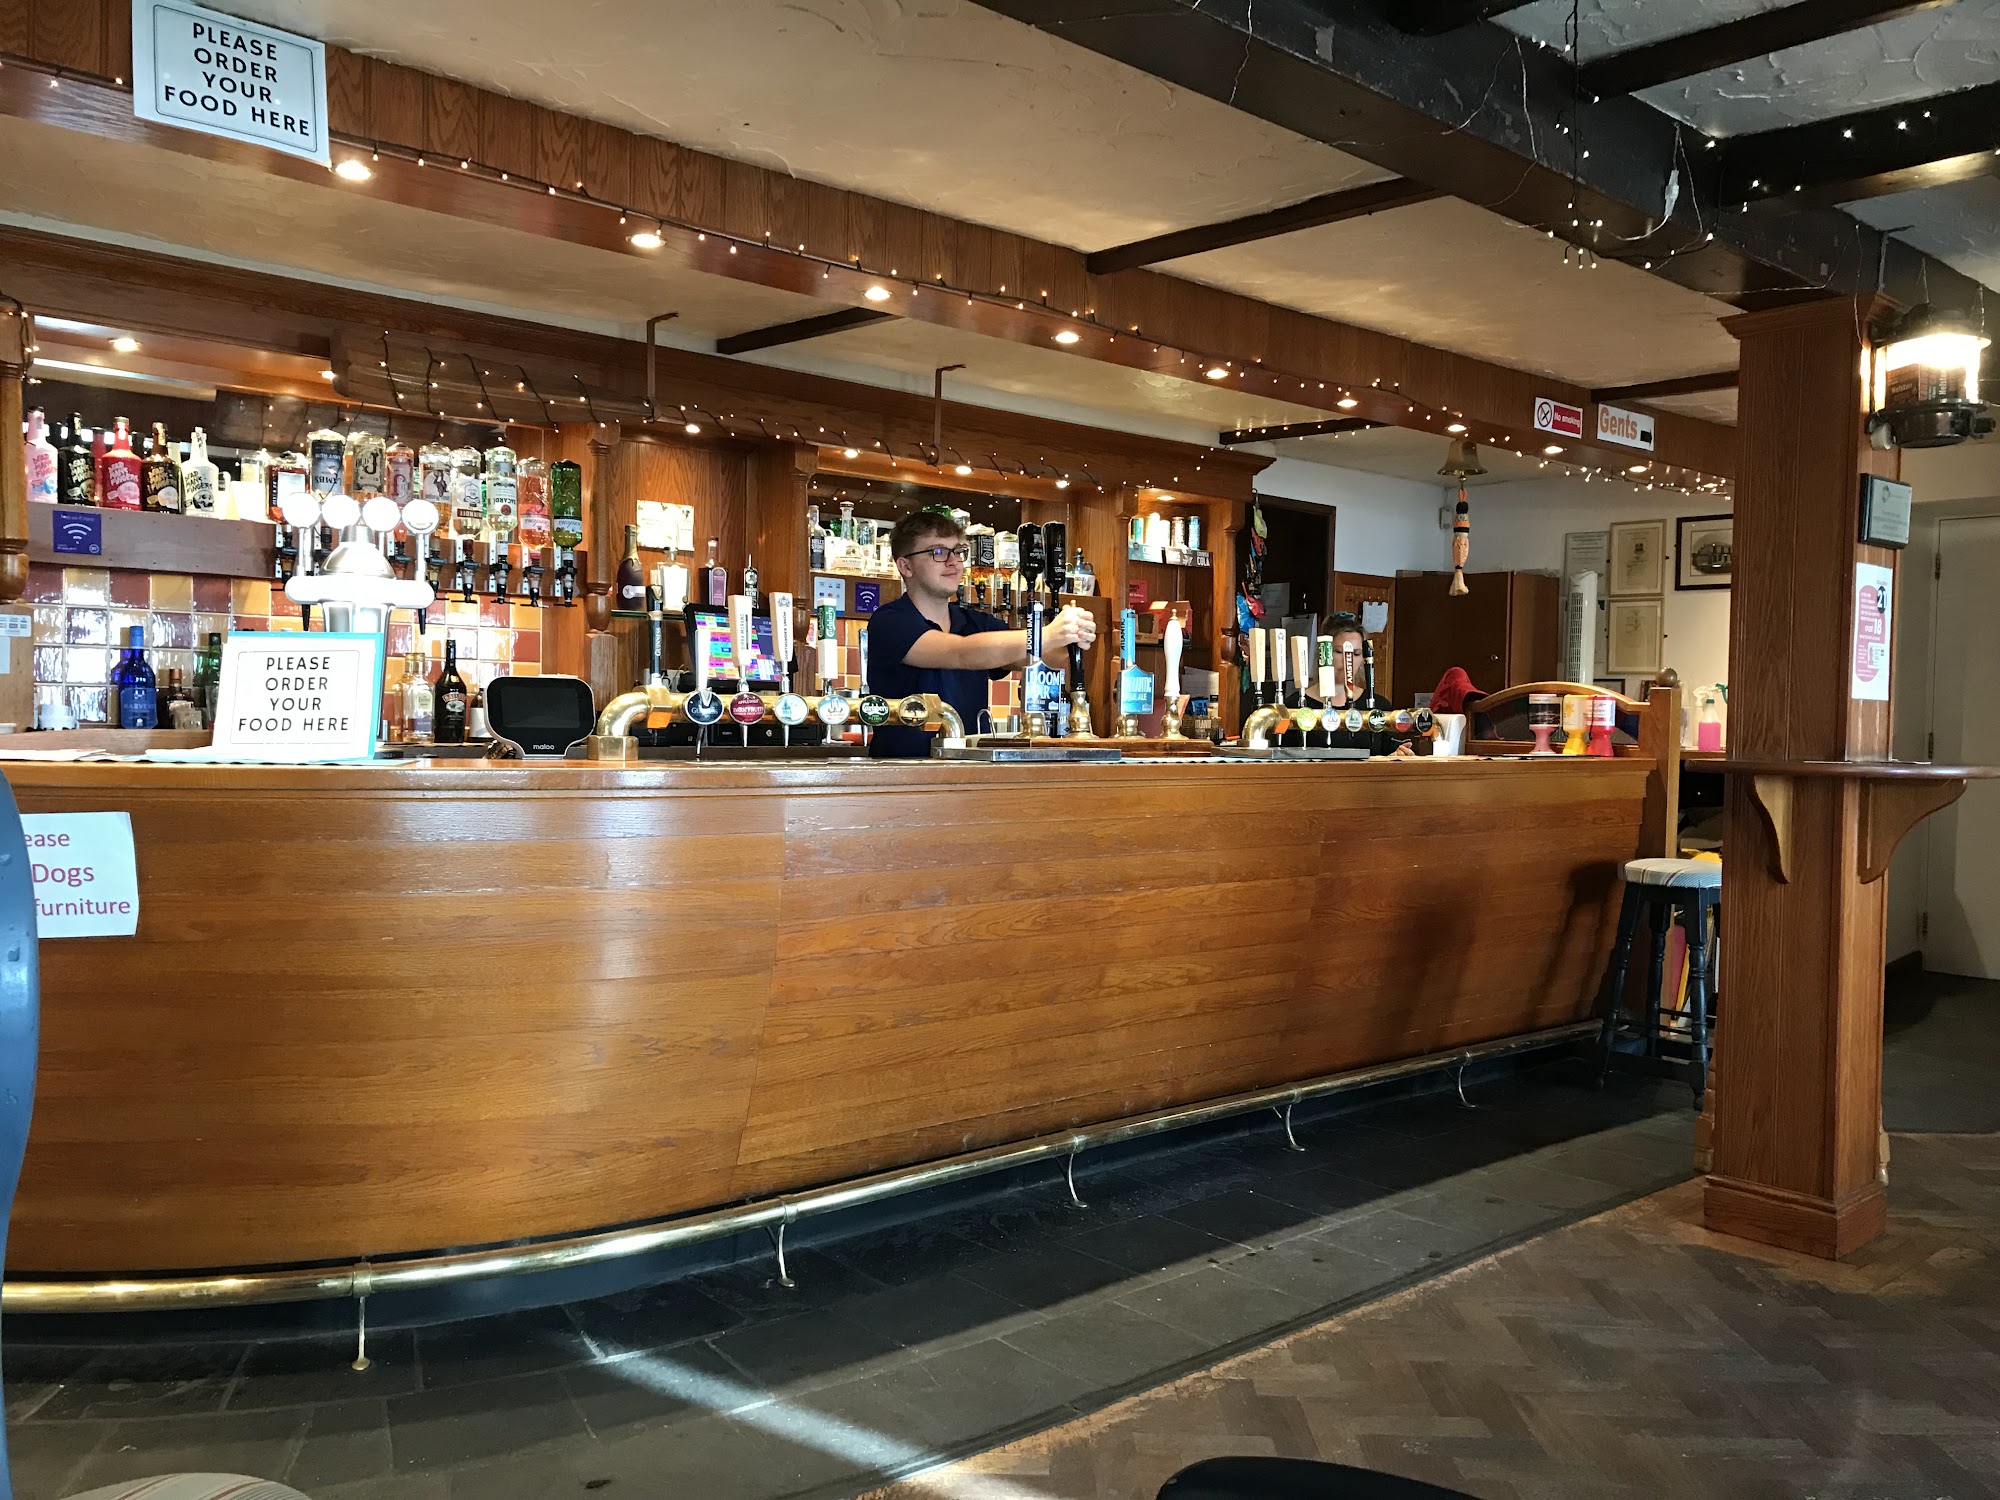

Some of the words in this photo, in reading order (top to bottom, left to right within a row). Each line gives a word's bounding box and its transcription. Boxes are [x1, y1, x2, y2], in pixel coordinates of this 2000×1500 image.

[193, 22, 277, 60] PLEASE
[194, 48, 277, 82] ORDER
[203, 71, 272, 103] YOUR
[165, 85, 237, 115] FOOD
[252, 107, 310, 136] HERE
[1554, 411, 1562, 421] No
[1562, 415, 1581, 427] smoking
[1600, 406, 1638, 440] Gents
[1196, 557, 1210, 567] COLA
[825, 607, 836, 638] Carlsberg
[1874, 618, 1883, 635] 18
[266, 656, 331, 670] PLEASE
[265, 677, 328, 691] ORDER
[1030, 671, 1060, 686] DOOM
[270, 697, 322, 711] YOUR
[691, 706, 718, 714] GUSS
[862, 701, 889, 716] Carlsberg
[238, 718, 292, 732] FOOD
[303, 717, 349, 731] HERE
[32, 863, 95, 888] Dogs
[35, 898, 131, 917] furniture
